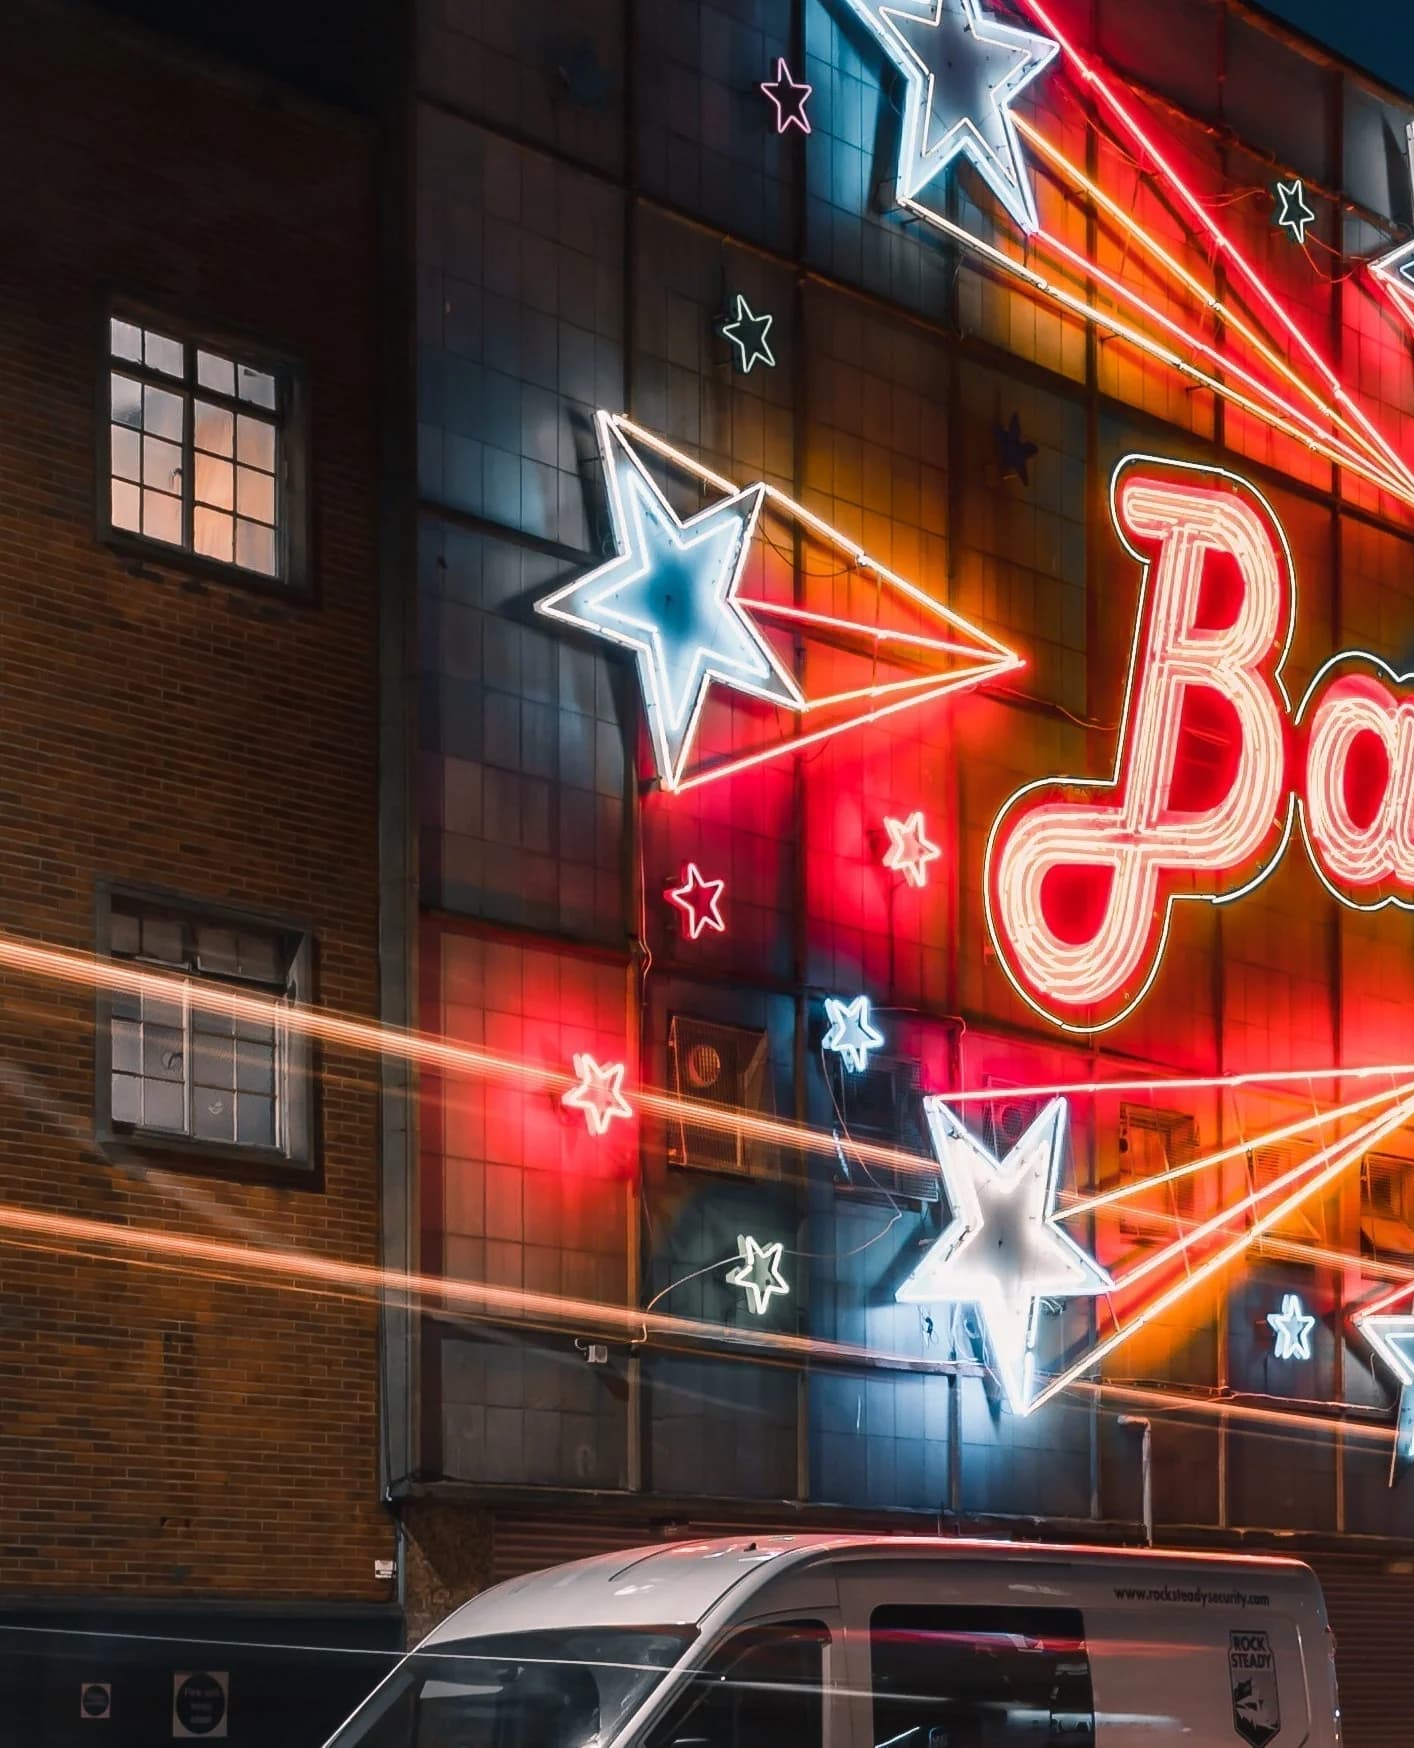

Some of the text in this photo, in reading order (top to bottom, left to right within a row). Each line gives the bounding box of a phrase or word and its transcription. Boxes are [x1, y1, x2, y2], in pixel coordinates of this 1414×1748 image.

[1113, 1585, 1270, 1608] www.rocksteadysecurity.com
[1233, 1635, 1267, 1651] ROCK
[1231, 1652, 1271, 1669] STEADY
